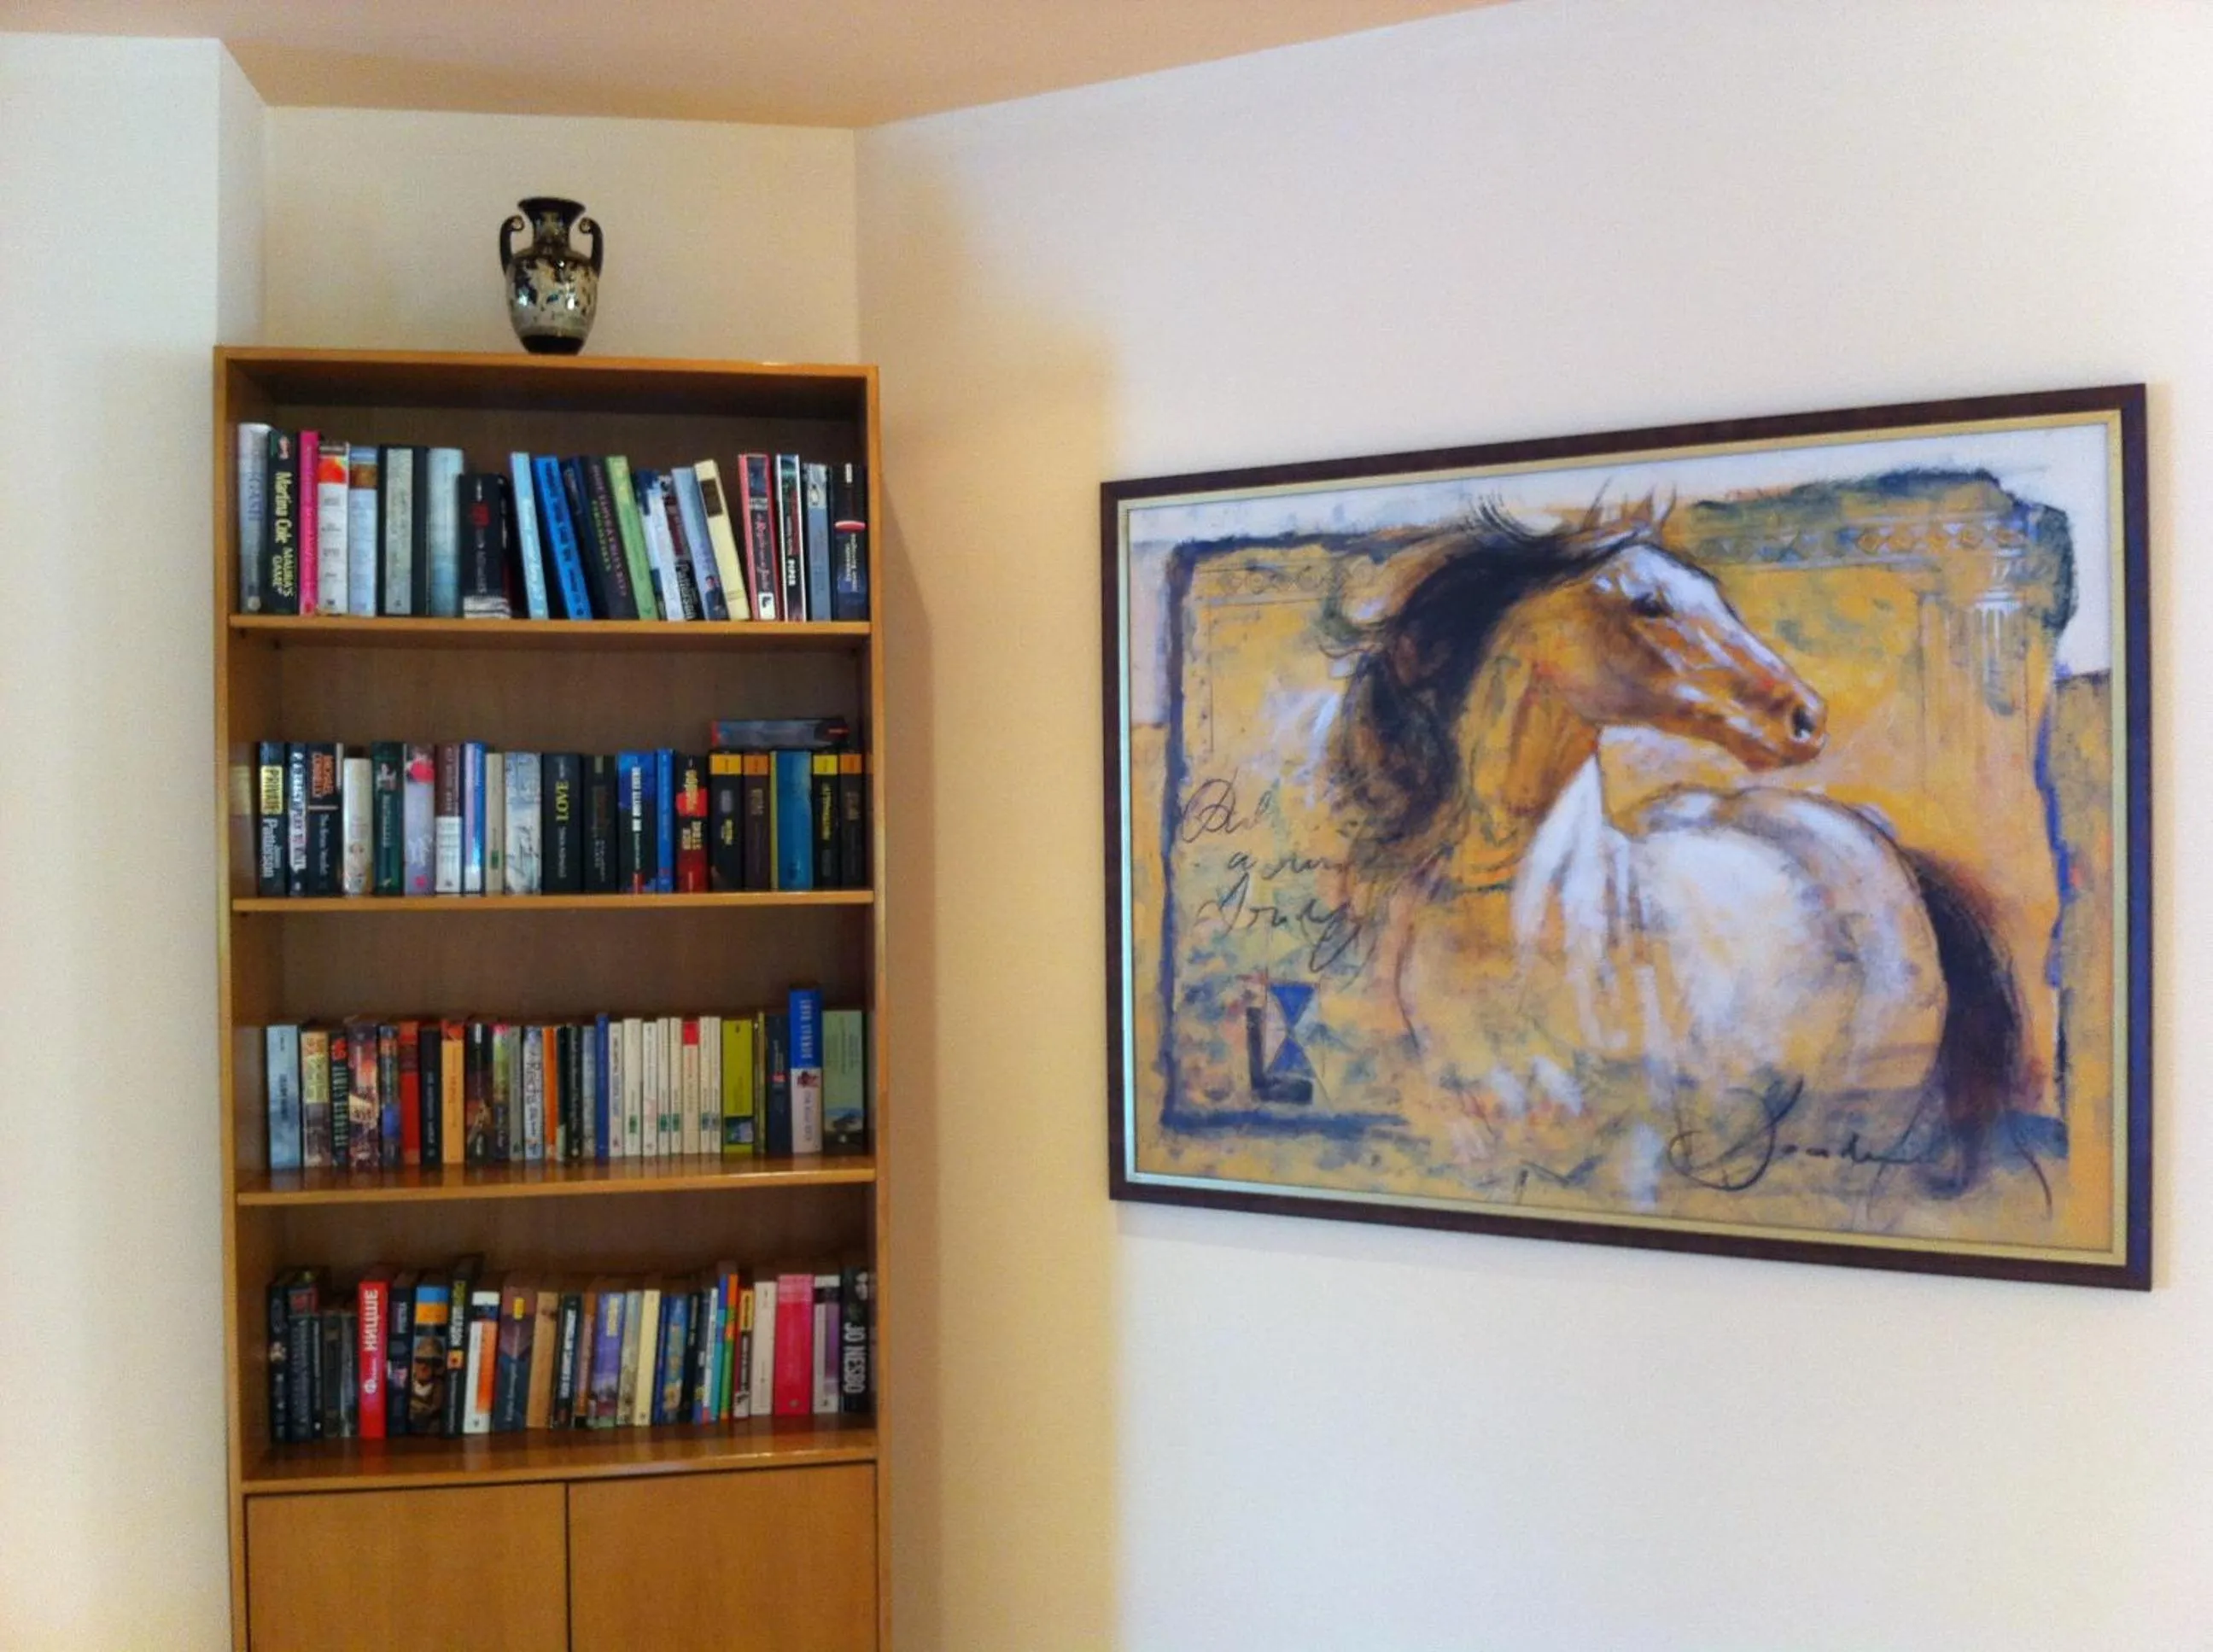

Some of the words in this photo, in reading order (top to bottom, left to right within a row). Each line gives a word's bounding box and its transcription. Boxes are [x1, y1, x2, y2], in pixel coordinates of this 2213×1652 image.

[555, 780, 569, 821] LOVE
[261, 818, 278, 879] Patterson
[362, 1288, 378, 1351] НИЦШЕ
